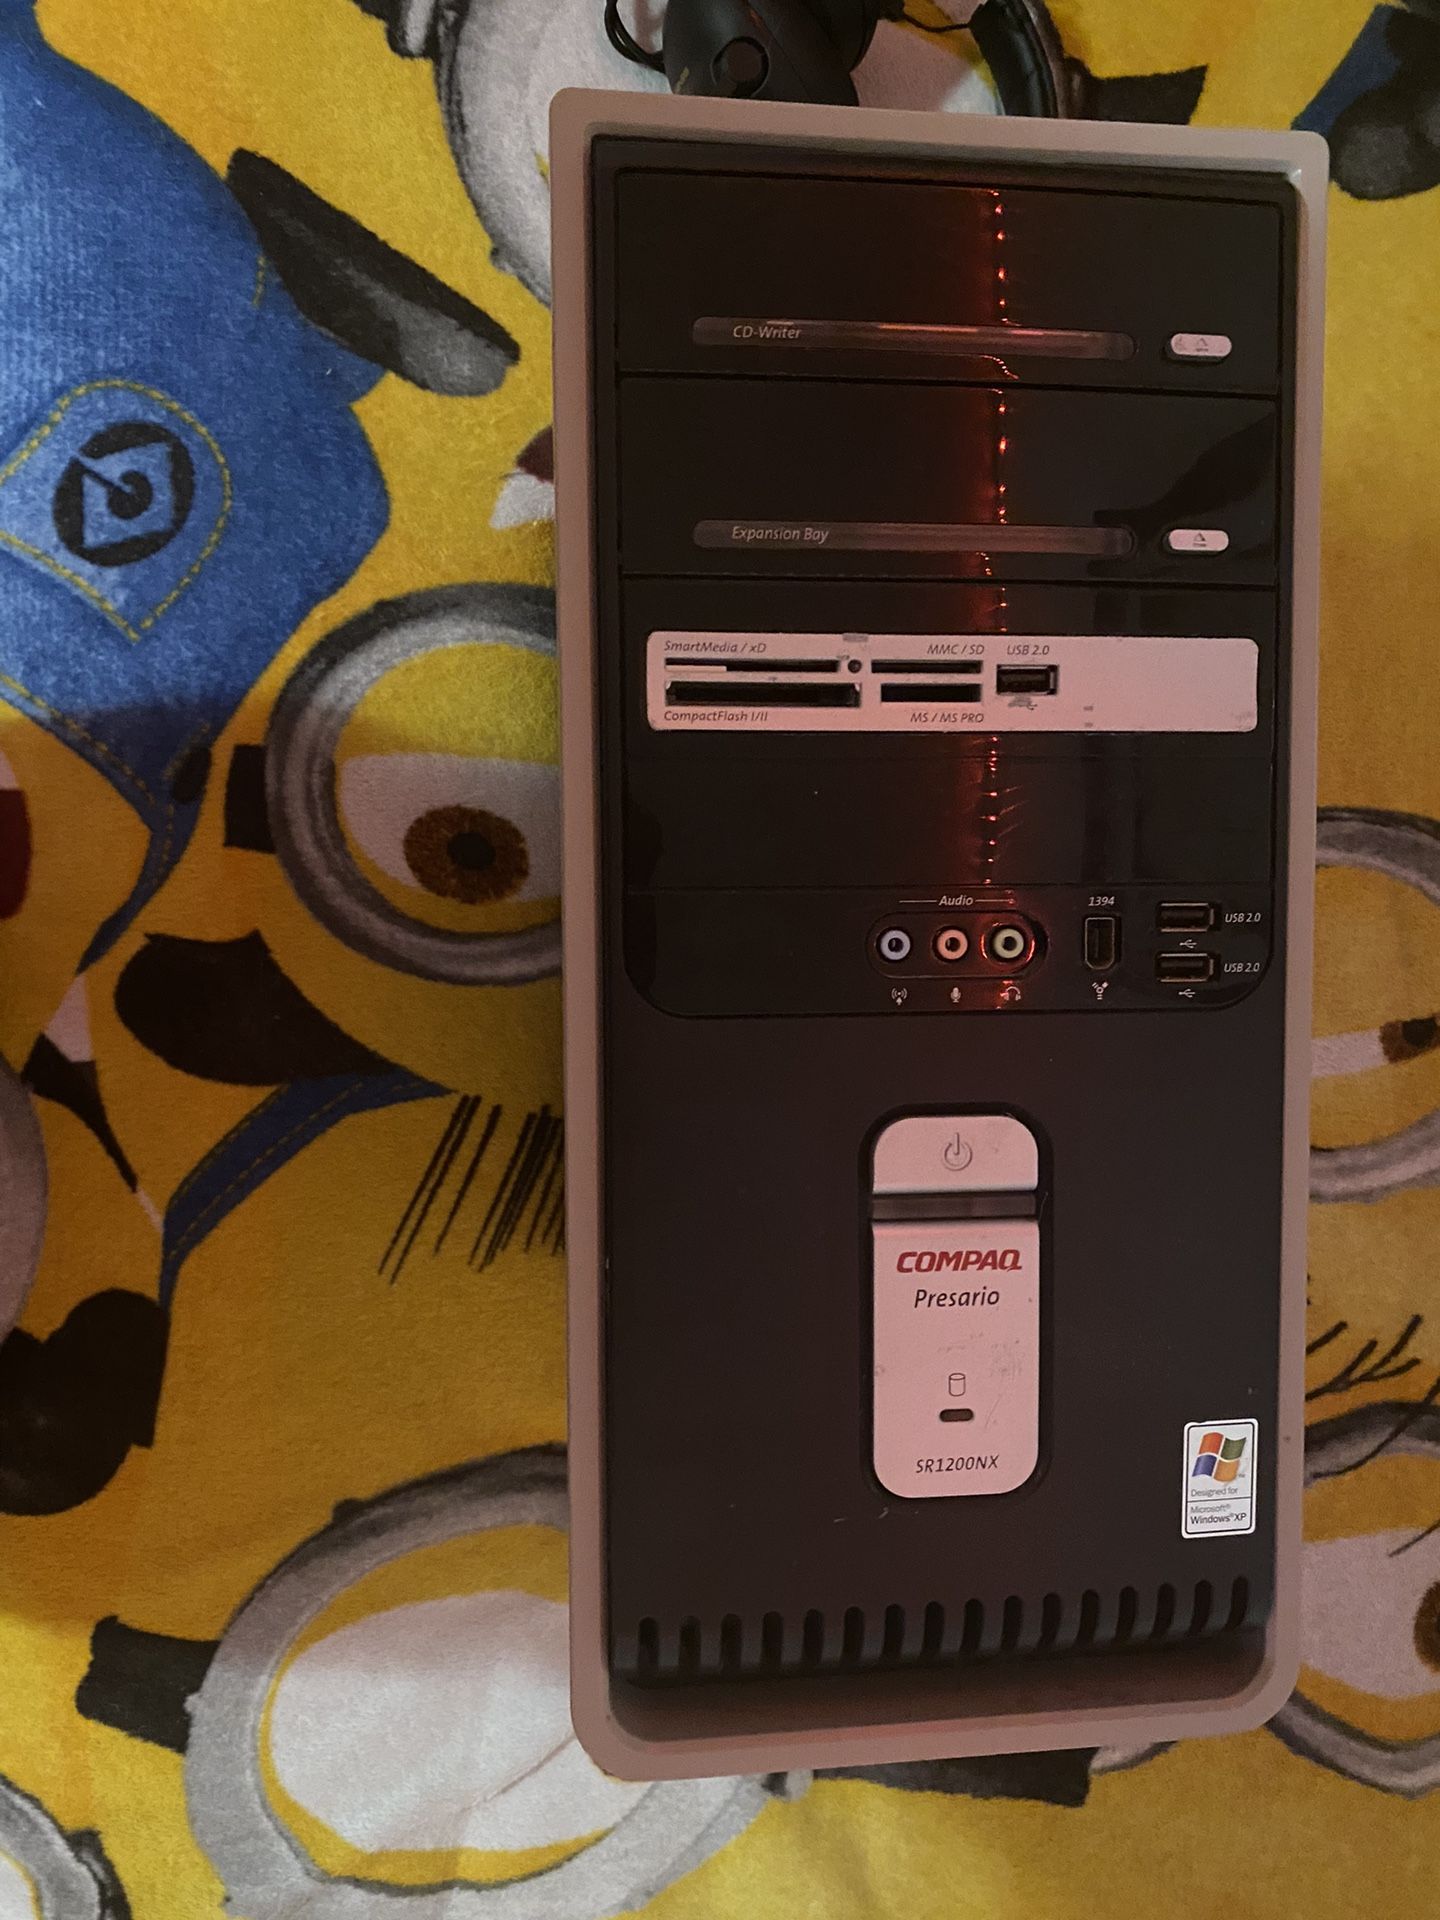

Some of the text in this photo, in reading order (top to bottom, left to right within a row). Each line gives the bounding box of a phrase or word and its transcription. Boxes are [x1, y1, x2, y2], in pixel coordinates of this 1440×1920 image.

[732, 325, 802, 339] CD-Writer
[731, 526, 829, 545] Expansion Bay
[664, 640, 738, 653] SmartMedia
[749, 643, 767, 653] xD
[927, 644, 960, 655] MMC
[969, 644, 985, 655] SD
[1006, 645, 1050, 656] USB 2.0
[664, 710, 748, 725] CompactFlash
[910, 713, 929, 723] MS
[939, 713, 958, 723] MS
[960, 713, 985, 723] PRO
[938, 895, 974, 906] Audio
[1088, 896, 1115, 907] 1394
[1225, 912, 1262, 923] USB 2.0
[1224, 962, 1261, 973] USB 2.0
[896, 1249, 1022, 1273] COMPAQ
[914, 1286, 1000, 1308] Presario
[916, 1455, 999, 1473] SR1200NX
[1191, 1486, 1238, 1497] Designed for
